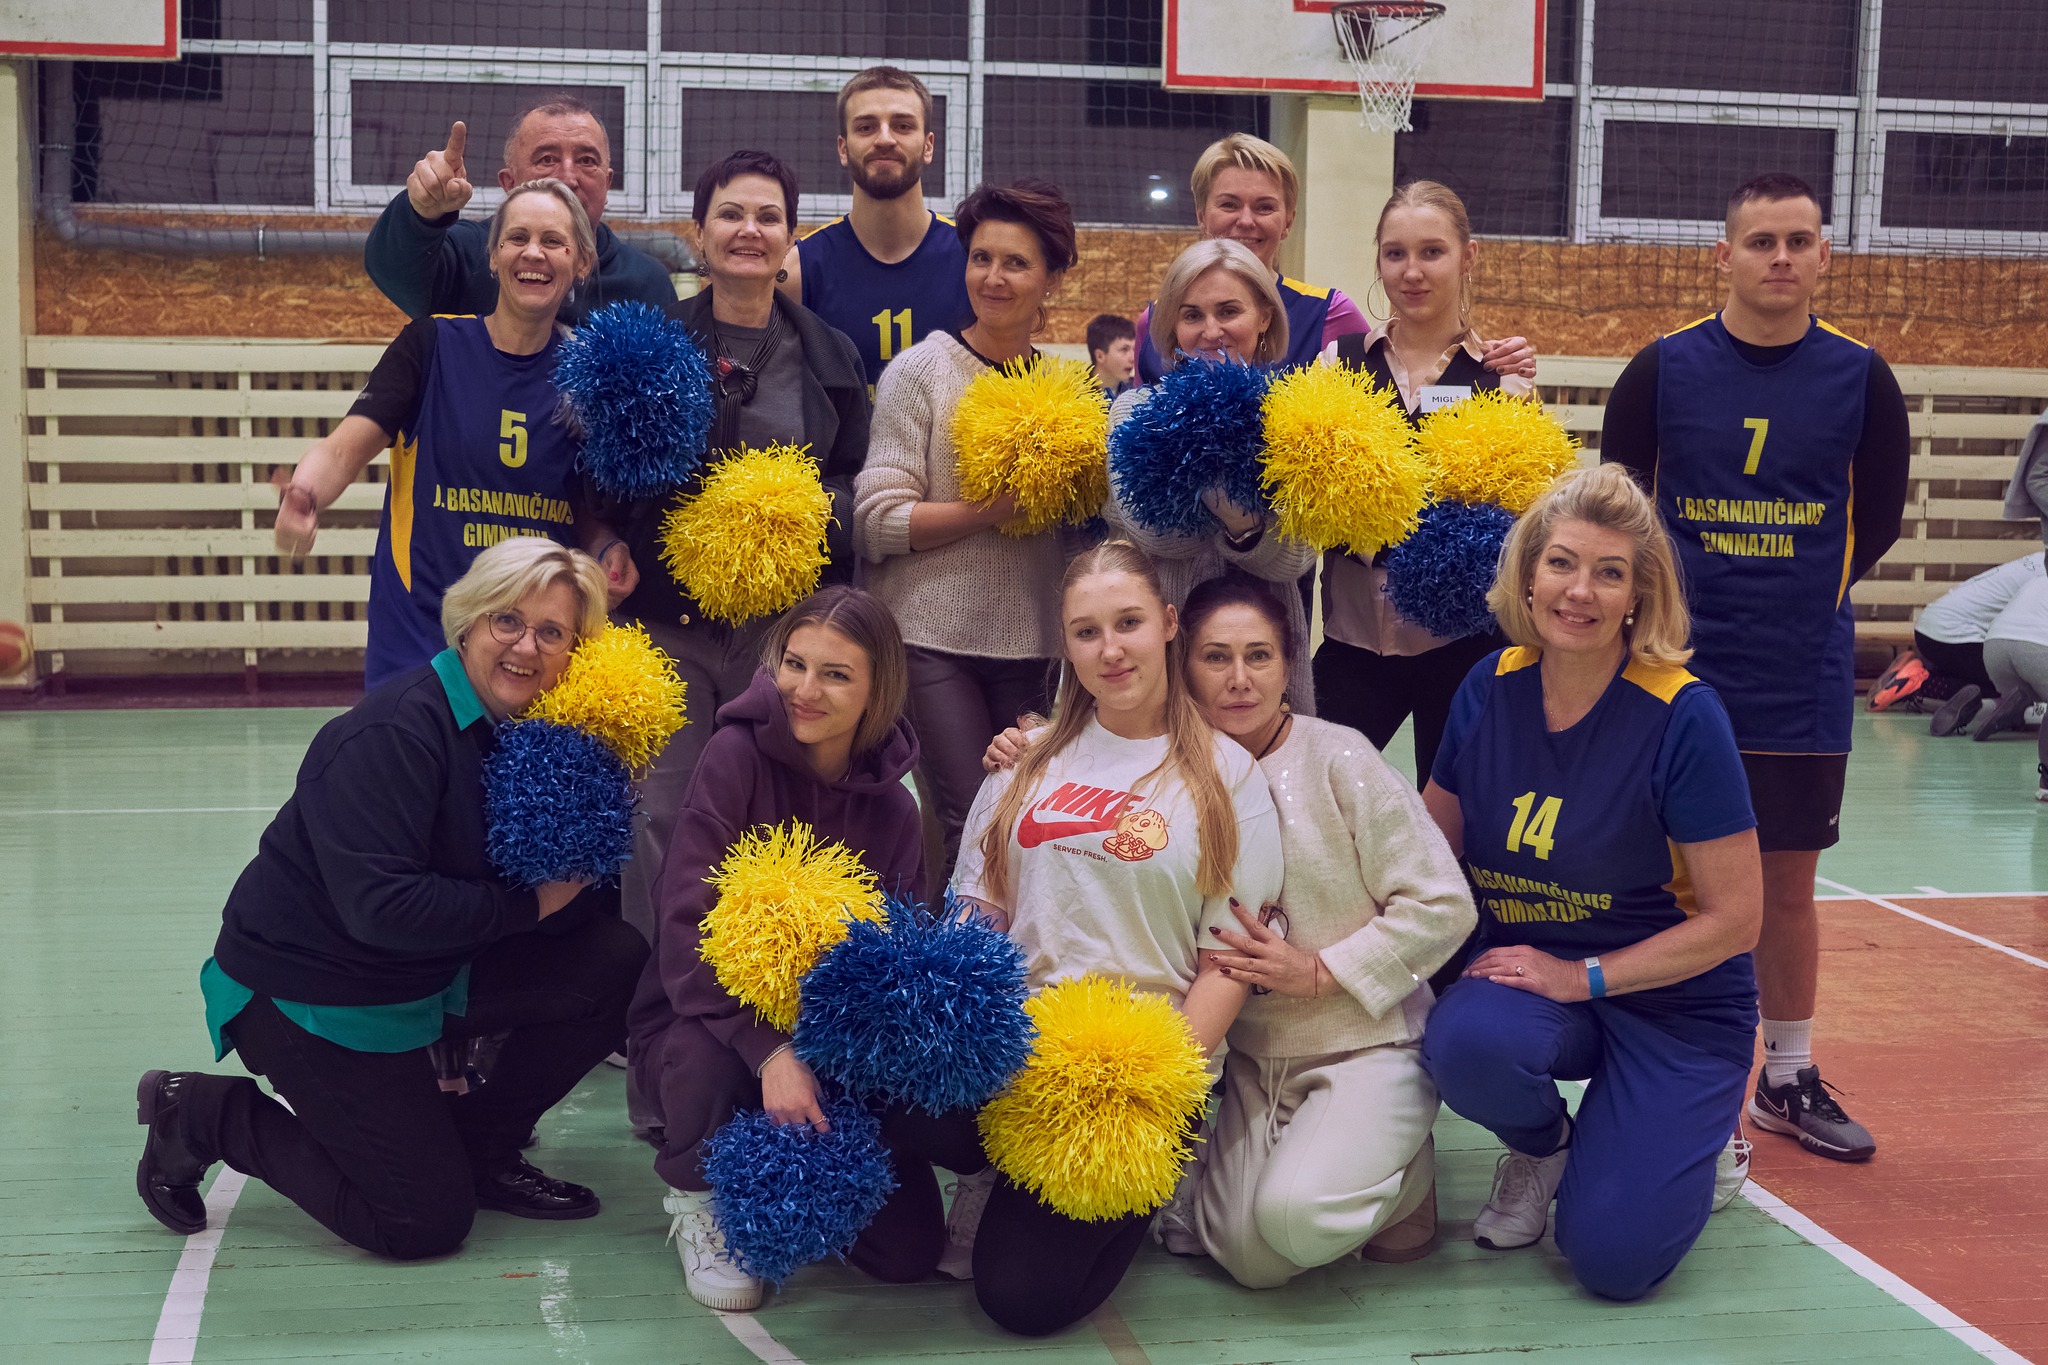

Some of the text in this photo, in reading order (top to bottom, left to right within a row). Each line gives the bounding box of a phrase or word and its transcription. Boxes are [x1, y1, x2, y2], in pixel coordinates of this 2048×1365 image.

[872, 308, 912, 360] 11
[499, 409, 528, 468] 5
[1743, 418, 1769, 475] 7
[1685, 497, 1826, 525] BASANAVIČIAUS
[1700, 531, 1795, 557] GIMNAZIJA
[1037, 782, 1147, 822] NIKE
[1506, 791, 1563, 861] 14
[1053, 843, 1108, 863] SERVED FRESH.
